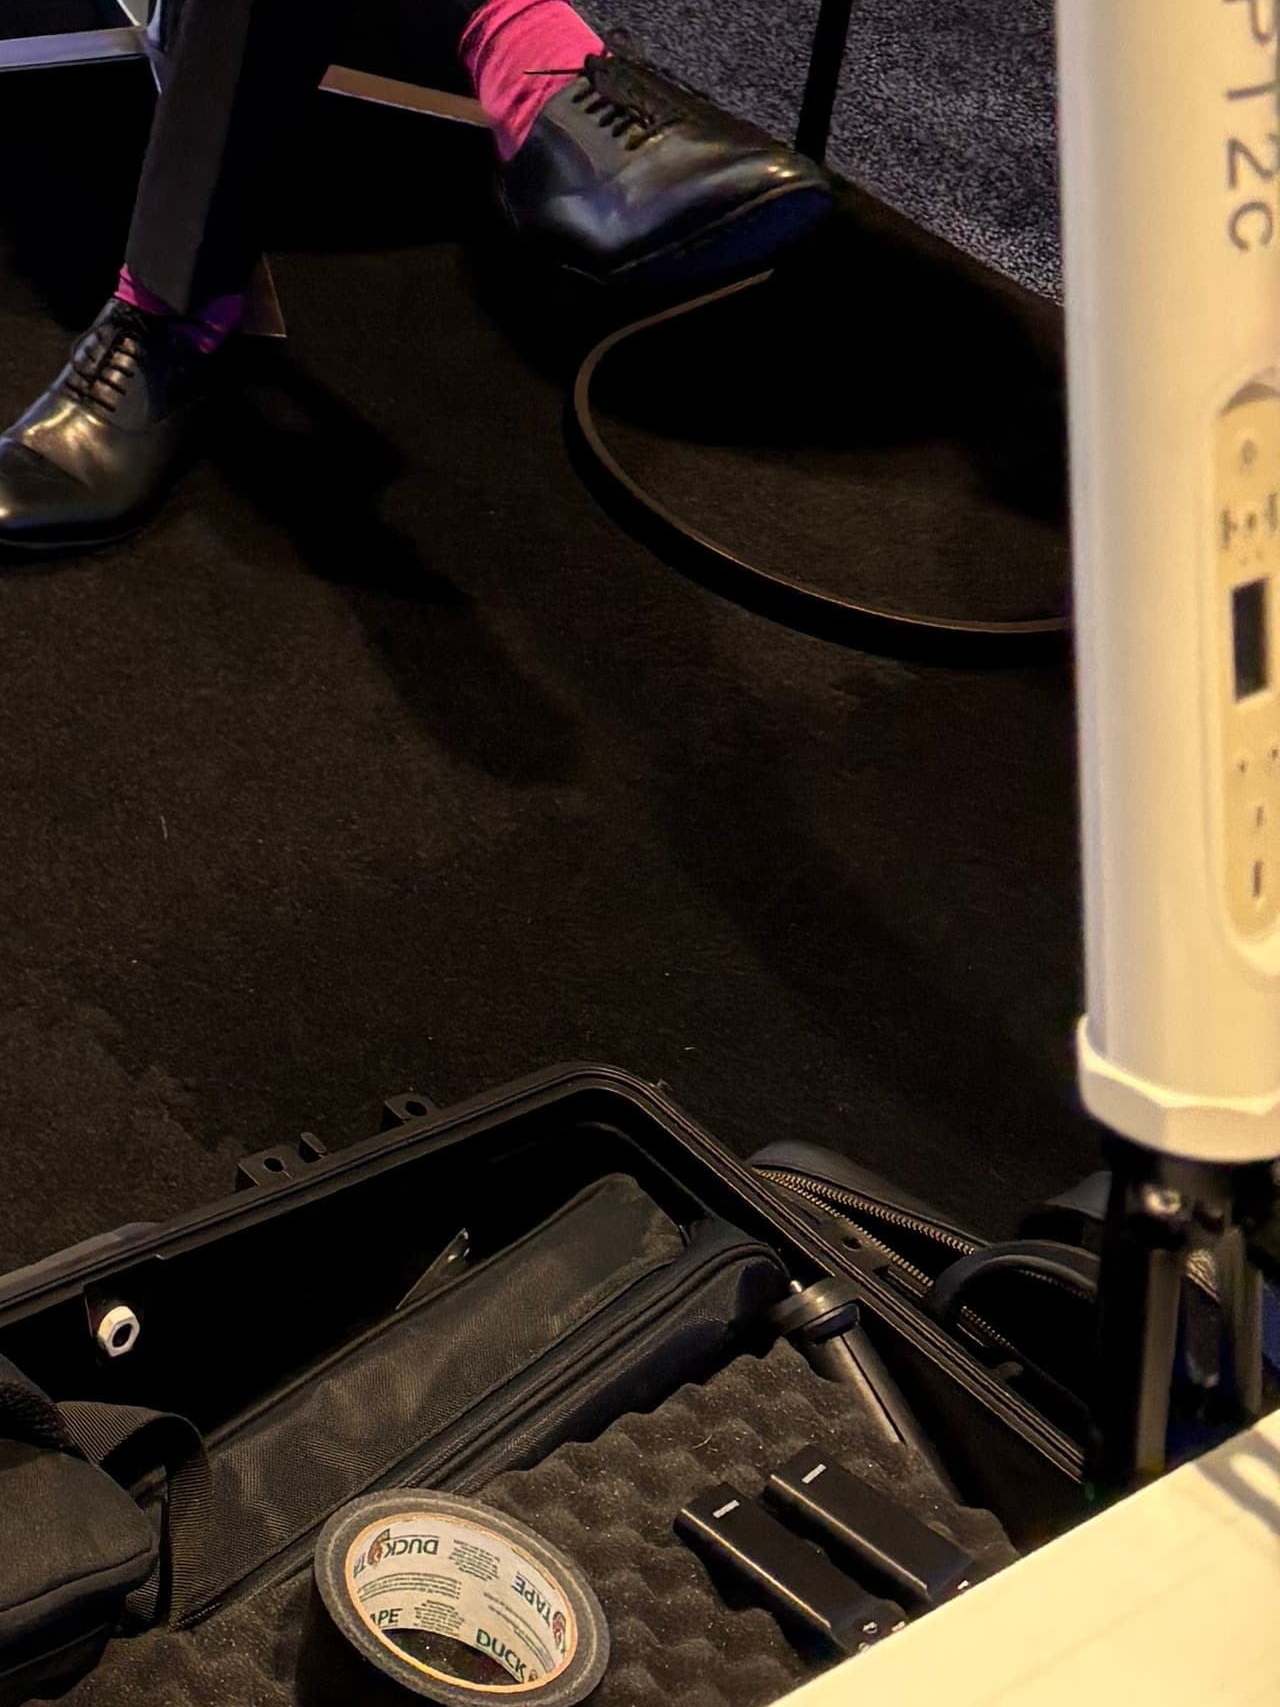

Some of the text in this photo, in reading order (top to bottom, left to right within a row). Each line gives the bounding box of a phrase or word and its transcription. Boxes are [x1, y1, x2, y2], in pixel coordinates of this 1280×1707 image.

[383, 1538, 440, 1558] DUCK
[510, 1574, 552, 1625] TAPE
[474, 1628, 527, 1684] DUCK
